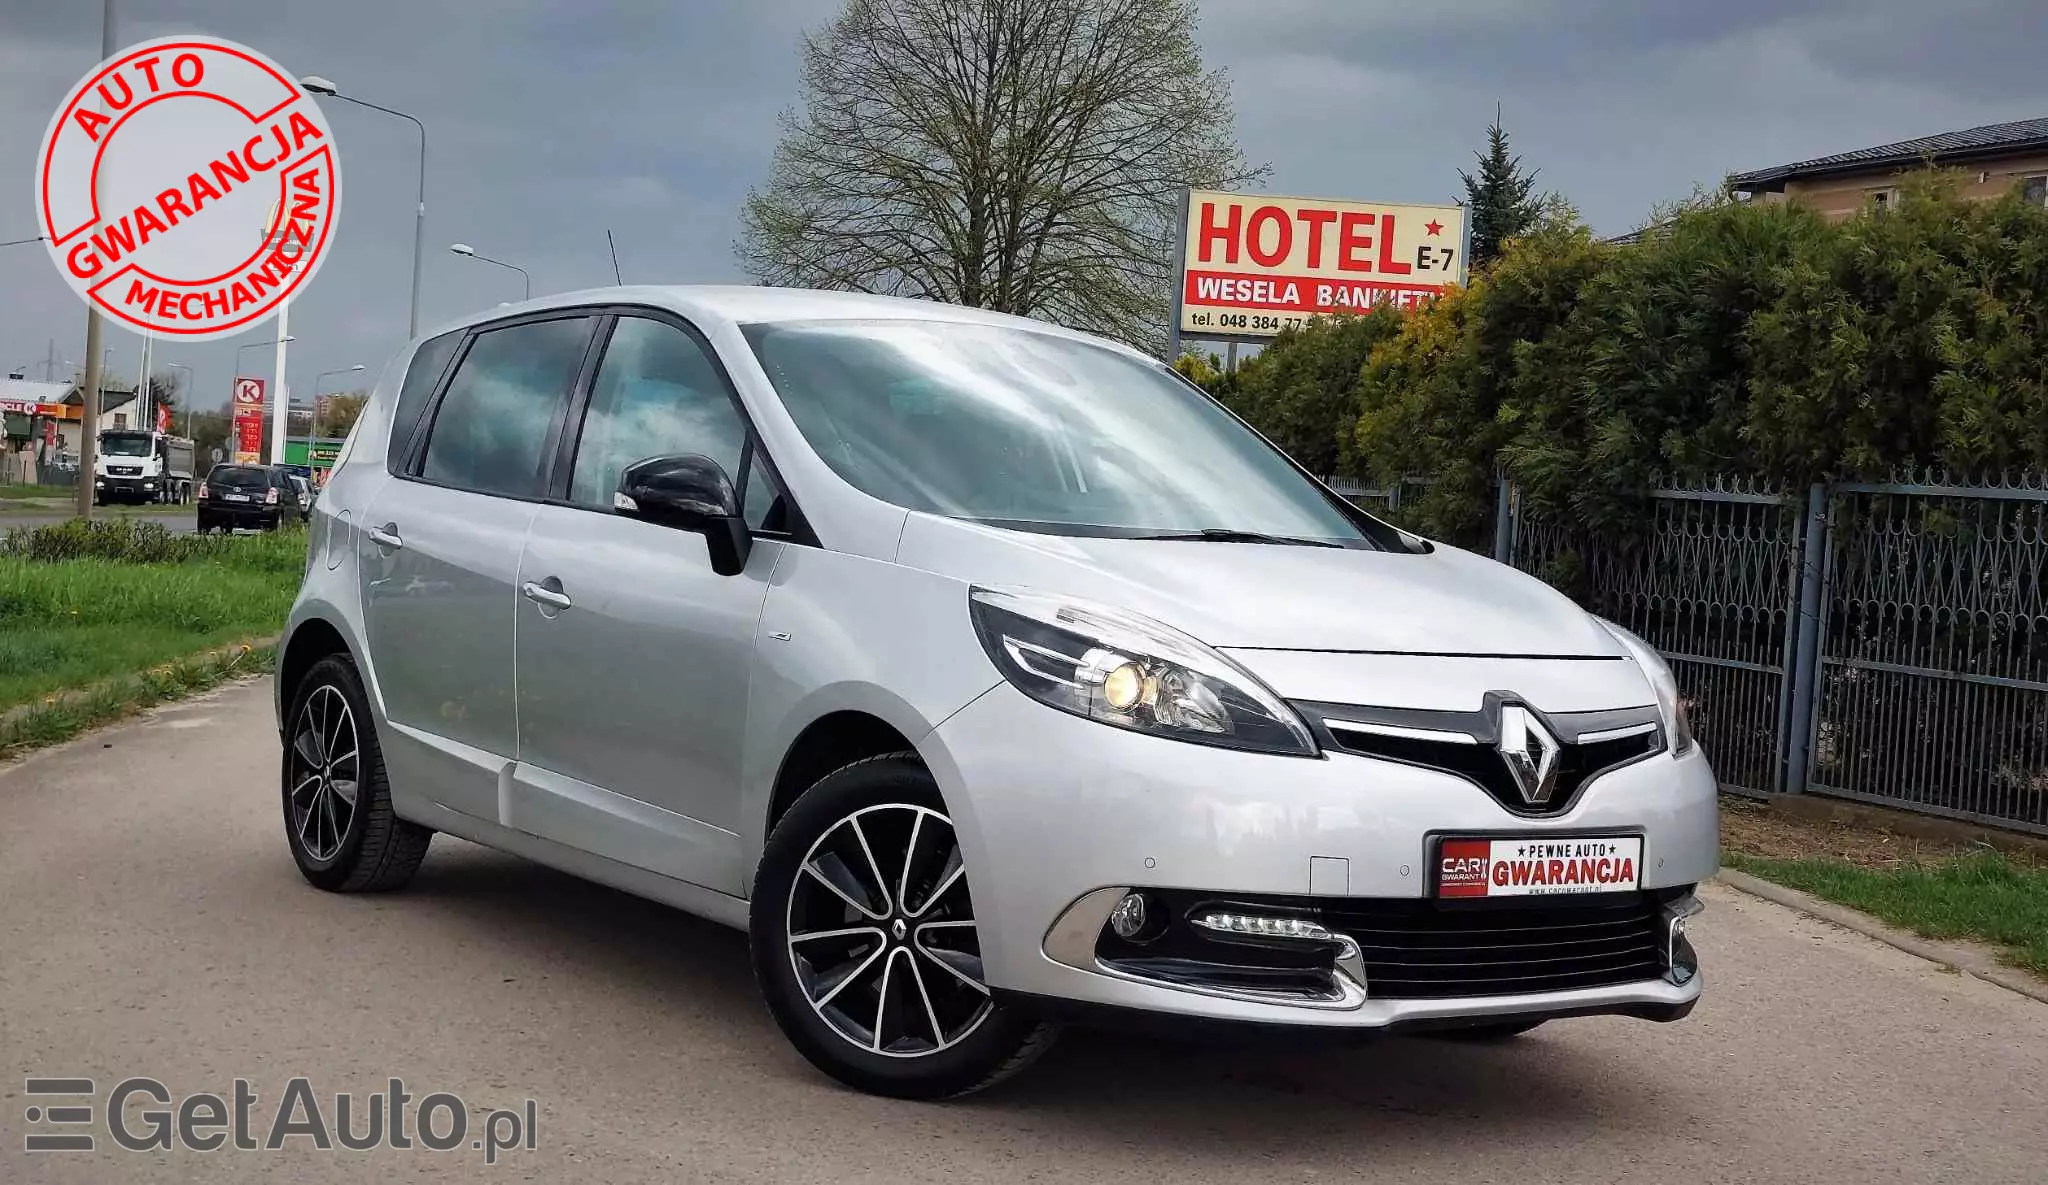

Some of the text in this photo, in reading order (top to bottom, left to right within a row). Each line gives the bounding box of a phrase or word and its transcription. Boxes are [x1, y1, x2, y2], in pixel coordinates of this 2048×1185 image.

[1197, 202, 1413, 276] HOTEL
[1417, 246, 1454, 272] E-7
[1197, 276, 1301, 305] WESELA
[1191, 313, 1215, 327] tel.
[1219, 314, 1247, 328] 048
[1252, 316, 1279, 330] 384
[1529, 843, 1606, 858] PEWNE AUTO
[1442, 857, 1481, 873] CAR
[1492, 858, 1634, 887] GWARANCJA
[1441, 873, 1481, 881] GWARANT
